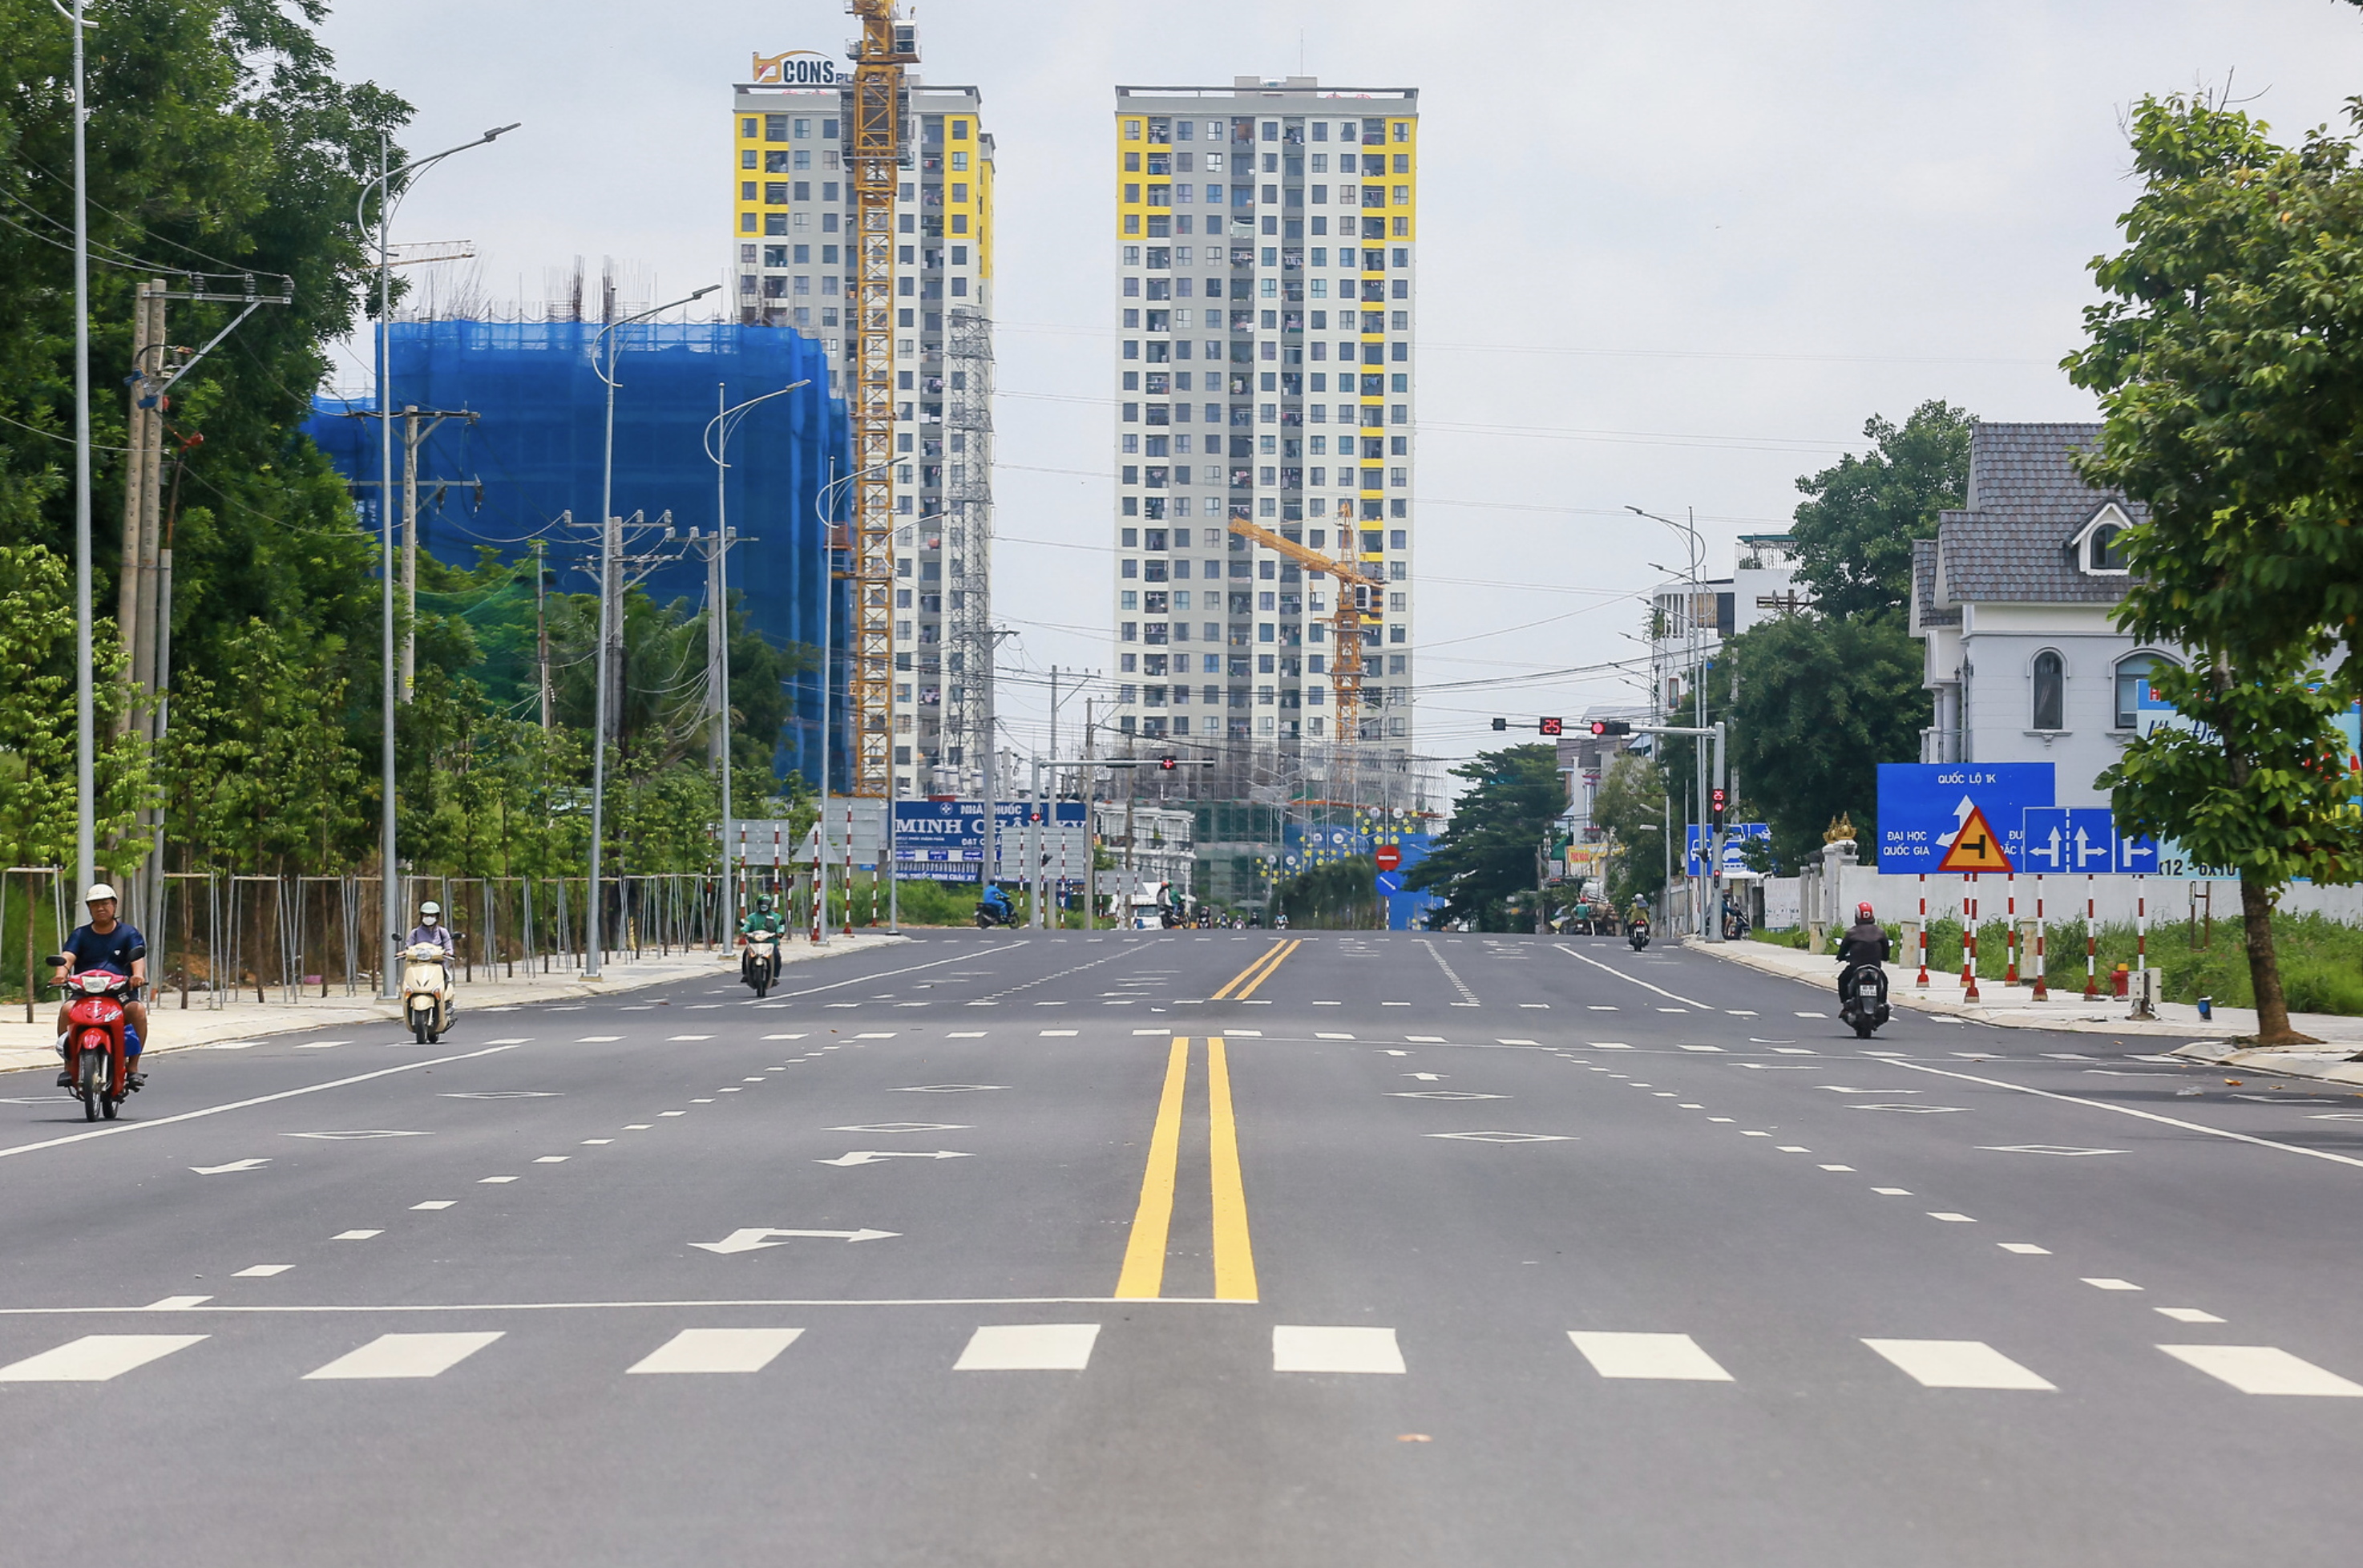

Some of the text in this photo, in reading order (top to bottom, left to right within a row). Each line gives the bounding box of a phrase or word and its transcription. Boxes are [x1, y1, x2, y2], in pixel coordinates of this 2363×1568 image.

[1544, 719, 1561, 734] 25
[1937, 770, 1997, 786] QUỐC LỘ 1K
[1714, 791, 1724, 801] 25
[960, 802, 1023, 814] NHÀ HUỐC
[895, 818, 963, 834] MINH
[1887, 830, 1927, 843] ĐẠI HỌC
[1884, 843, 1931, 855] QUỐC GIA
